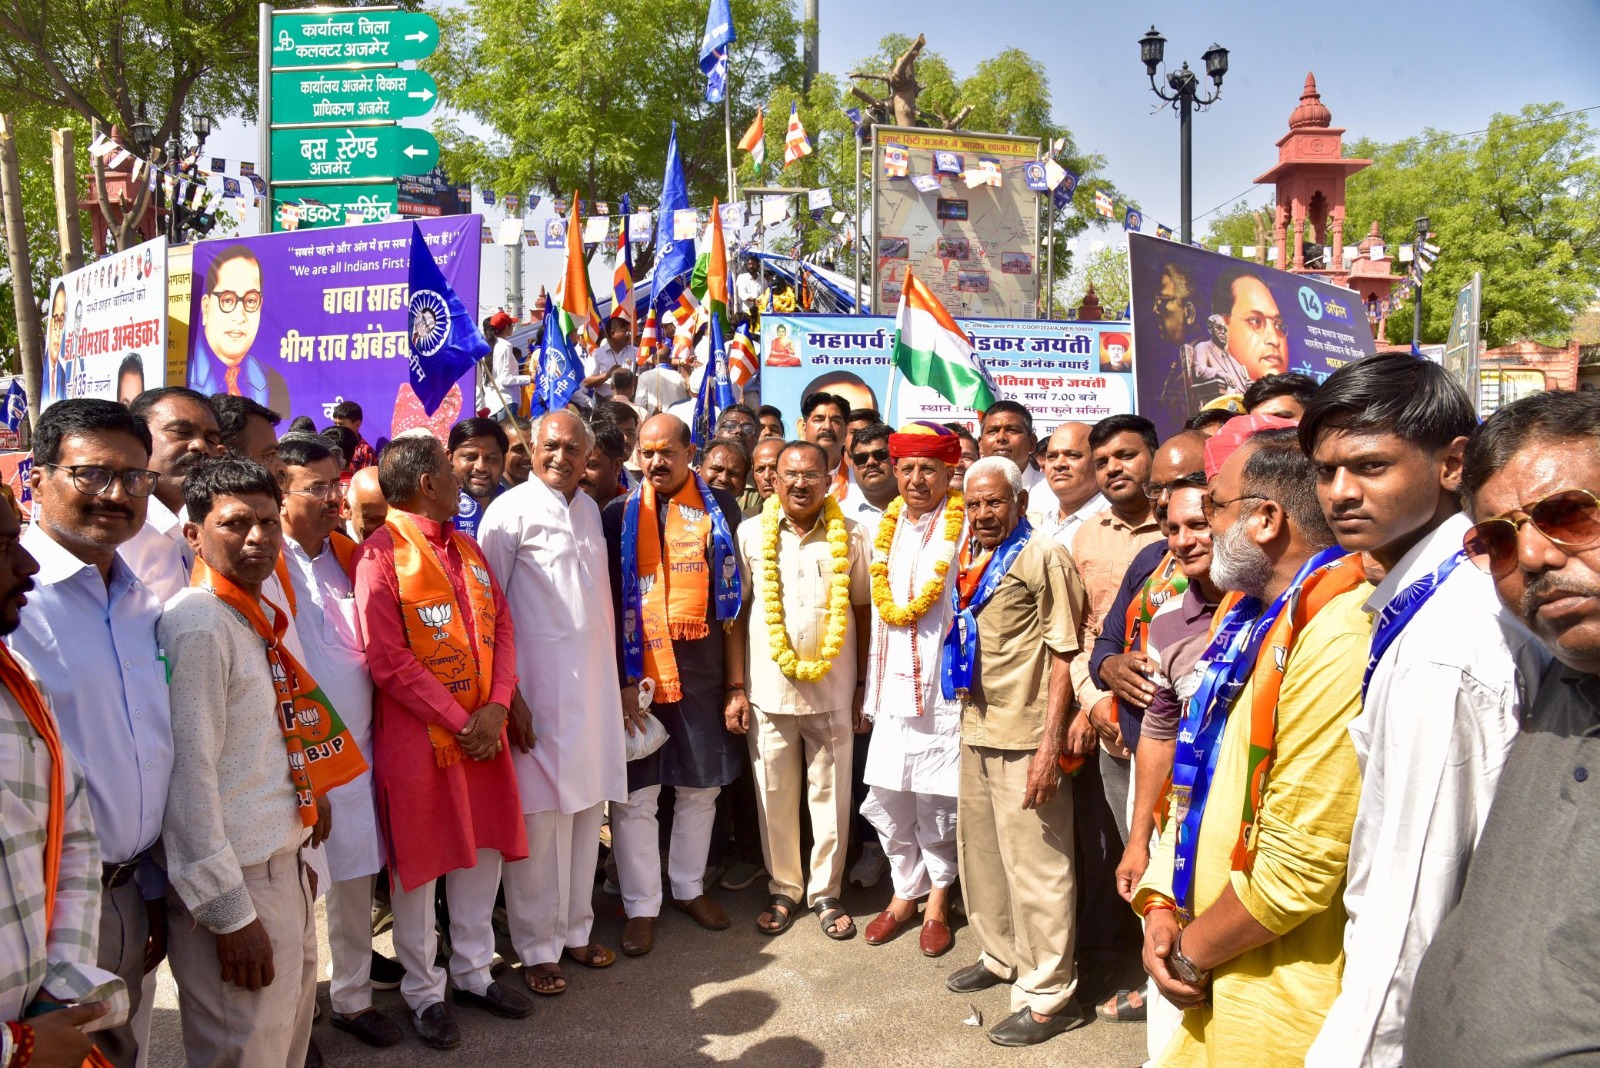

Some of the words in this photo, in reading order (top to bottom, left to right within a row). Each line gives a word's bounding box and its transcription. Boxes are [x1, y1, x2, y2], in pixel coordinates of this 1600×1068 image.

[301, 18, 355, 37] कार्यालय
[358, 17, 390, 35] जिला
[295, 43, 343, 58] कलक्टर
[343, 37, 390, 57] अजमेर
[300, 76, 340, 94] कार्यालय
[341, 74, 374, 93] अजमेर
[375, 73, 407, 92] विकास
[313, 98, 355, 117] प्राधिकरण
[357, 97, 390, 115] अजमेर
[300, 139, 328, 160] बस
[336, 129, 378, 160] स्टेण्ड
[903, 135, 920, 146] सिटी
[923, 136, 948, 148] अजमेर
[310, 156, 352, 175] अजमेर
[316, 242, 334, 257] पहले
[336, 241, 352, 254] और
[353, 240, 367, 253] अंत
[378, 240, 390, 252] हम
[392, 238, 406, 250] सब
[312, 265, 328, 275] are
[330, 262, 342, 274] all
[344, 259, 380, 273] Indians
[382, 257, 404, 269] First
[323, 285, 365, 315] बाबा
[367, 282, 409, 313] साह
[1301, 293, 1319, 313] 14
[77, 327, 110, 358] भीमराव
[112, 316, 160, 352] अम्बेडकर
[280, 329, 316, 363] भीम
[318, 334, 349, 362] राव
[807, 328, 886, 349] महापर्व
[1029, 333, 1093, 354] जयंती
[811, 355, 829, 365] की
[833, 356, 872, 365] समस्त
[1037, 376, 1064, 391] फुले
[1067, 376, 1107, 388] जयंती
[1024, 390, 1048, 401] सायं
[1051, 392, 1076, 401] 7.00
[1078, 391, 1098, 402] बजे
[919, 404, 952, 413] स्थान
[1051, 404, 1072, 417] फुले
[1075, 403, 1111, 415] सर्किल
[671, 561, 705, 573] भाजपा
[305, 736, 345, 763] BJP
